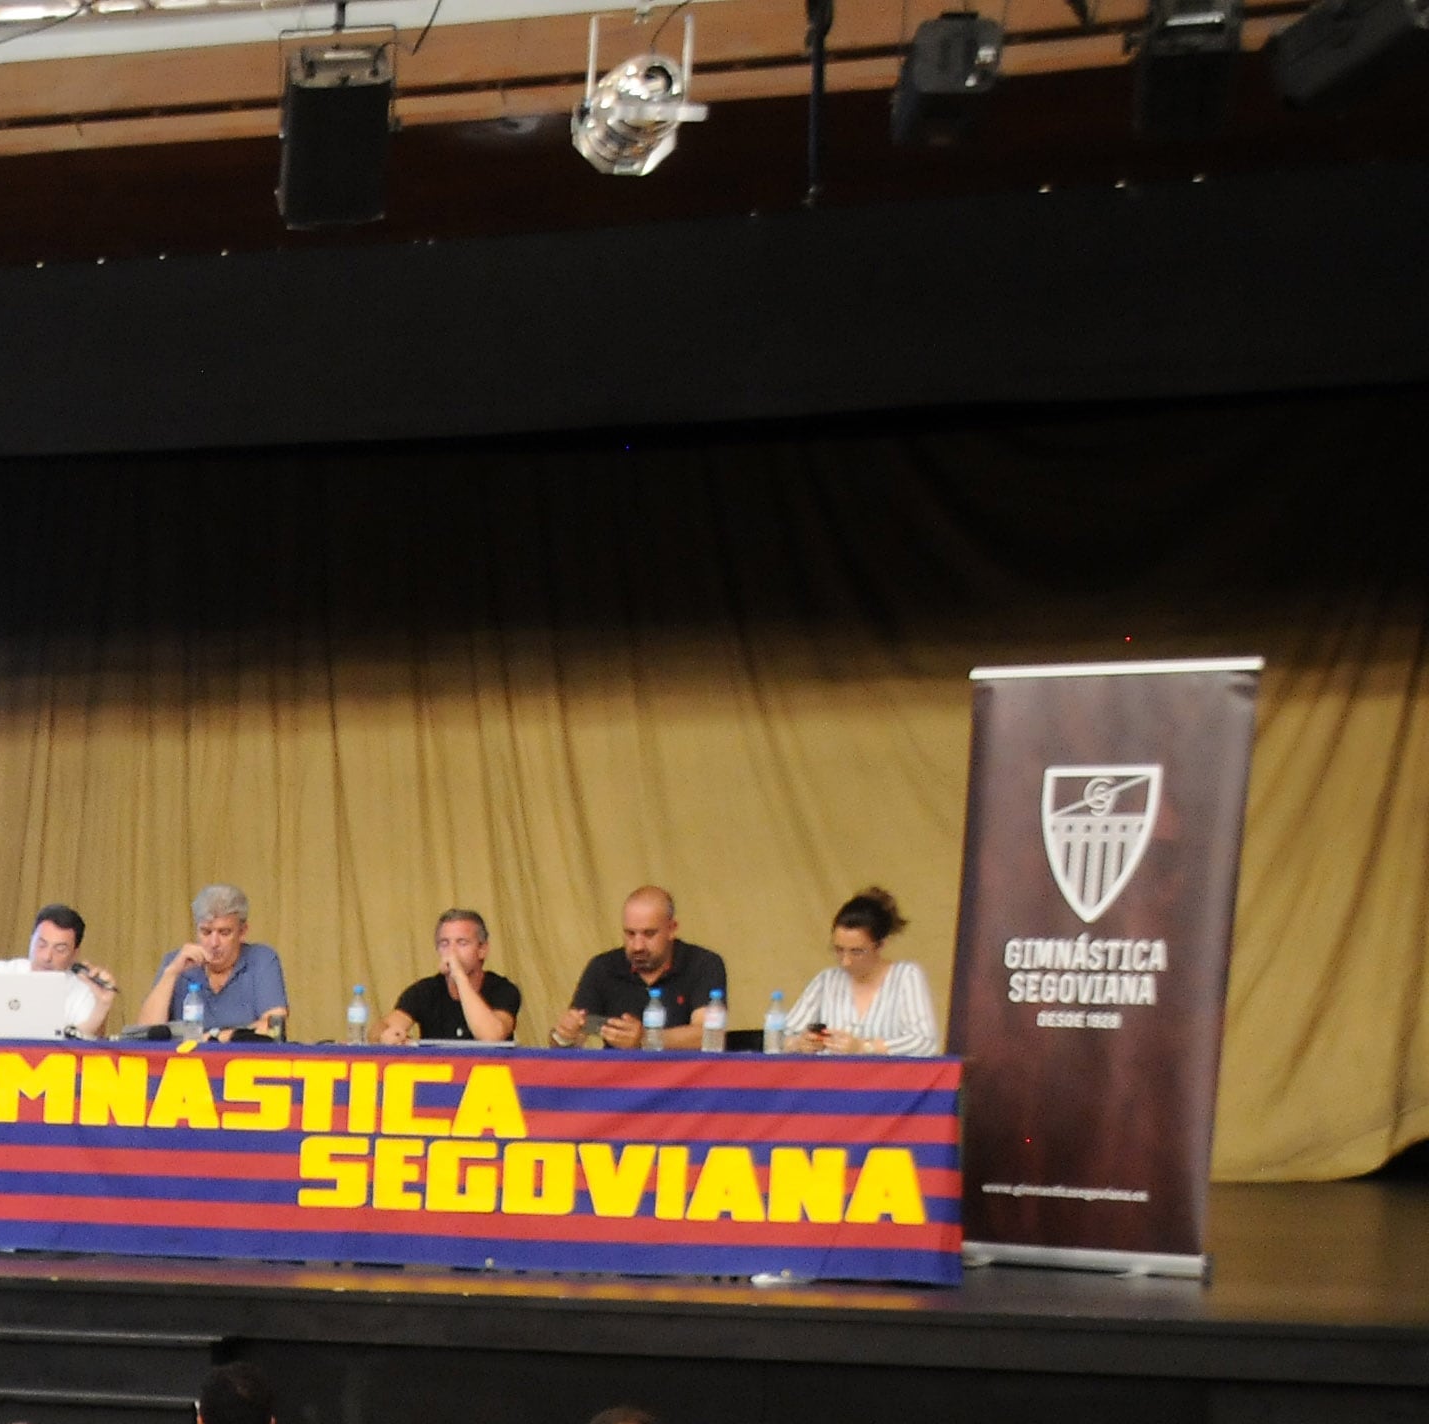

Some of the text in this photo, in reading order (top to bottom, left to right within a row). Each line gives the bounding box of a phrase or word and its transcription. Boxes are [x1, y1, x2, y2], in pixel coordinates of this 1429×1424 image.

[1004, 932, 1168, 972] GIMNÁSTICA
[1008, 972, 1157, 1005] SEGOVIANA
[297, 1136, 926, 1225] SEGOVIANA
